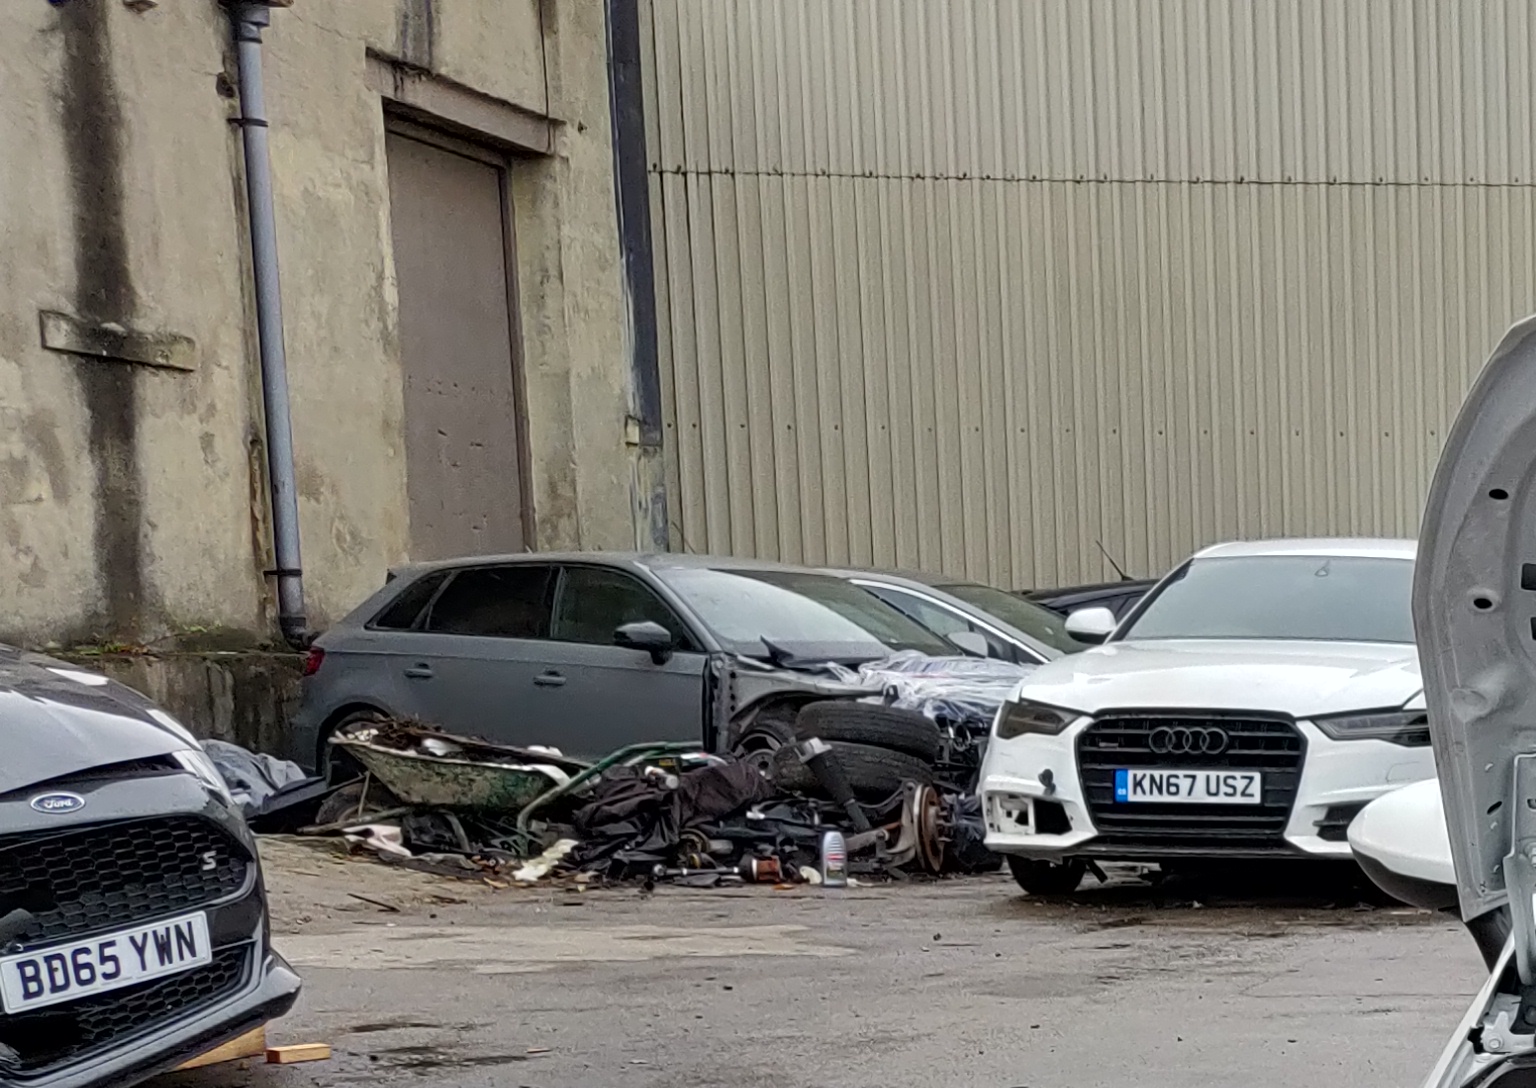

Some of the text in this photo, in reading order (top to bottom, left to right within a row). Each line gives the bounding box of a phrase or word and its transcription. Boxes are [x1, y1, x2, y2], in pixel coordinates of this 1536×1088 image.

[1132, 773, 1256, 798] KN67 USZ
[16, 920, 198, 1001] BD65 YWN
